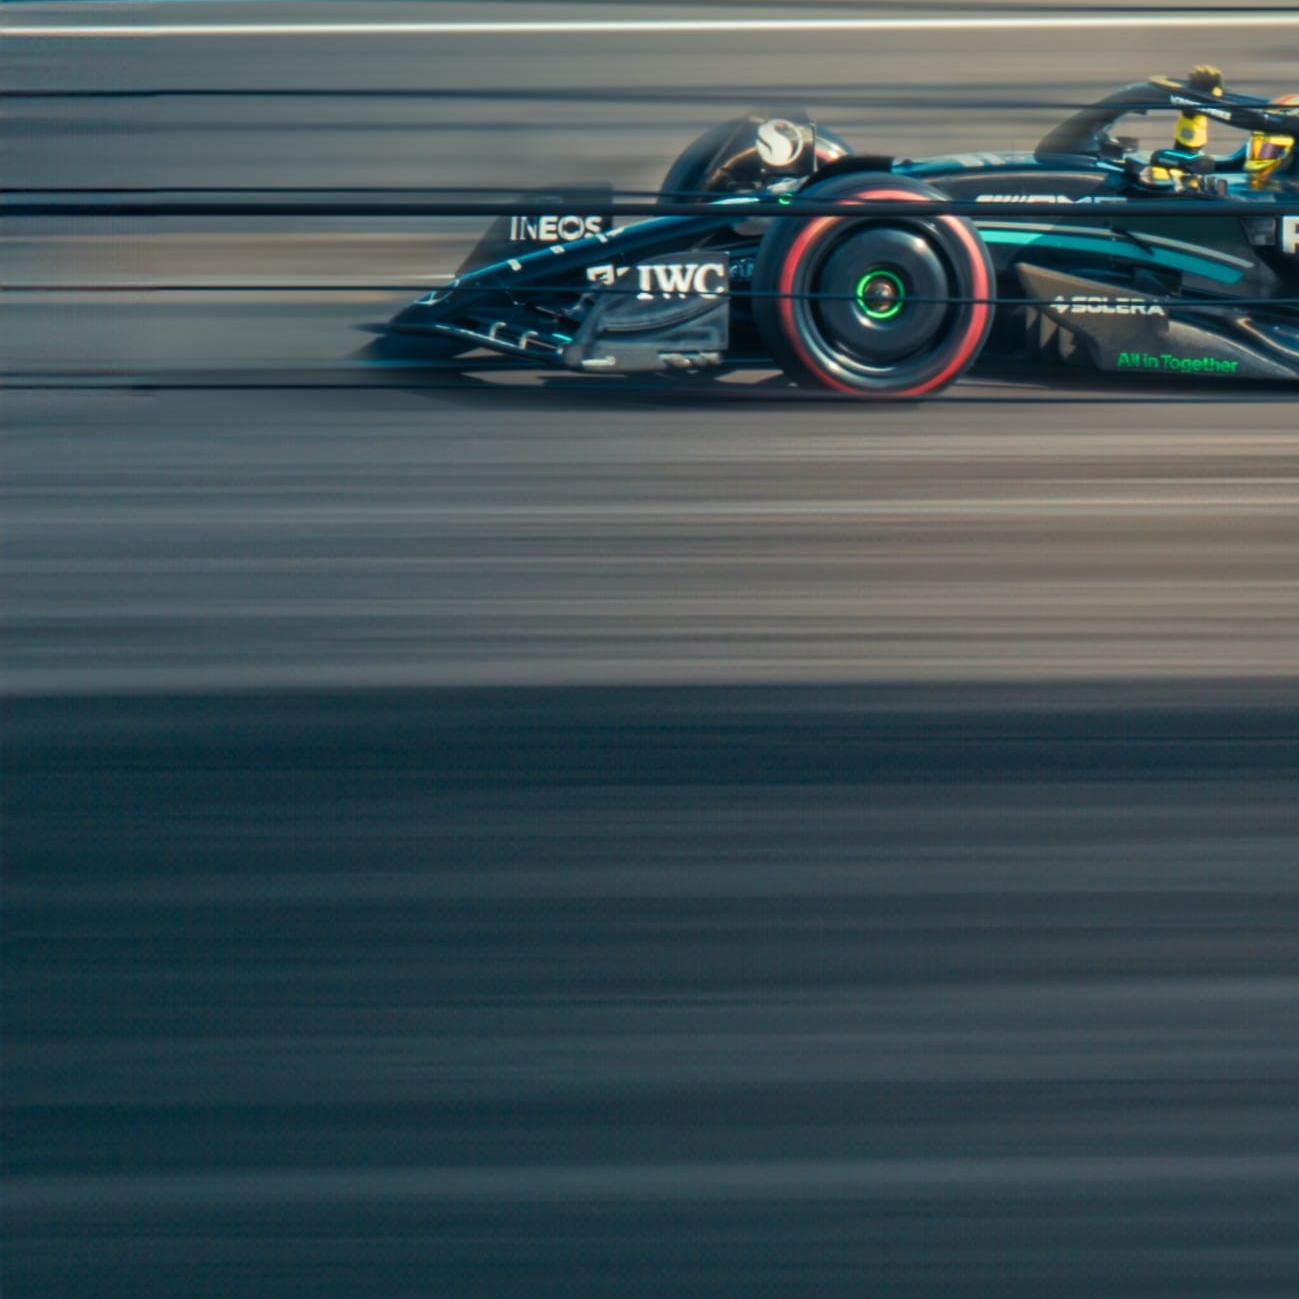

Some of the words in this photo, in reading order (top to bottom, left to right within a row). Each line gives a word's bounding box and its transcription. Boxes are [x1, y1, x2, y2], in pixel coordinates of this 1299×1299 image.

[510, 215, 603, 241] INEOS
[636, 263, 725, 300] IWC
[1071, 296, 1166, 316] SOLERA
[1117, 352, 1140, 368] All
[1143, 353, 1158, 368] in
[1160, 355, 1239, 373] Together
